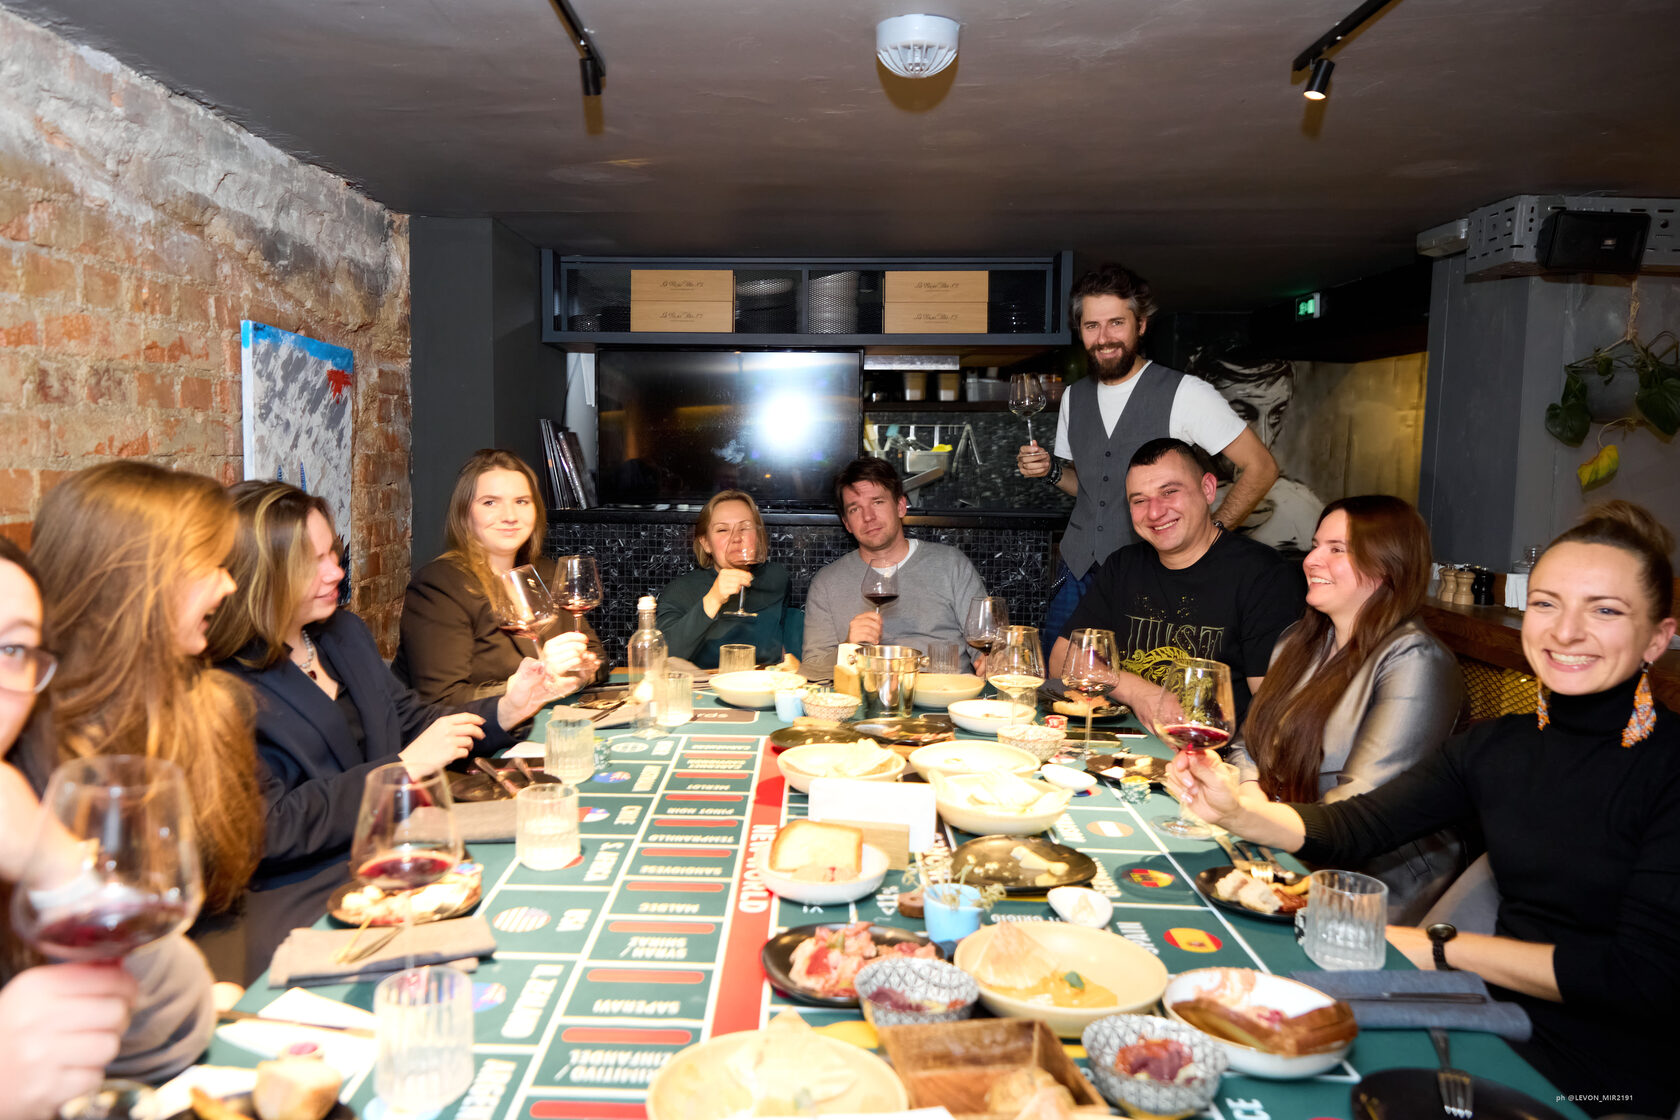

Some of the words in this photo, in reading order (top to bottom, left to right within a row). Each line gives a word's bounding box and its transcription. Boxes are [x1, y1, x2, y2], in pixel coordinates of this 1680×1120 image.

[686, 783, 730, 791] MERLOT
[667, 807, 697, 815] NOIR
[700, 807, 735, 815] PINOT
[648, 833, 735, 843] TEMPRANILLO
[639, 865, 723, 877] SANGIOVESE
[638, 902, 700, 914] MALBEC
[555, 908, 592, 932] USA
[592, 999, 681, 1016] SAPERAVI
